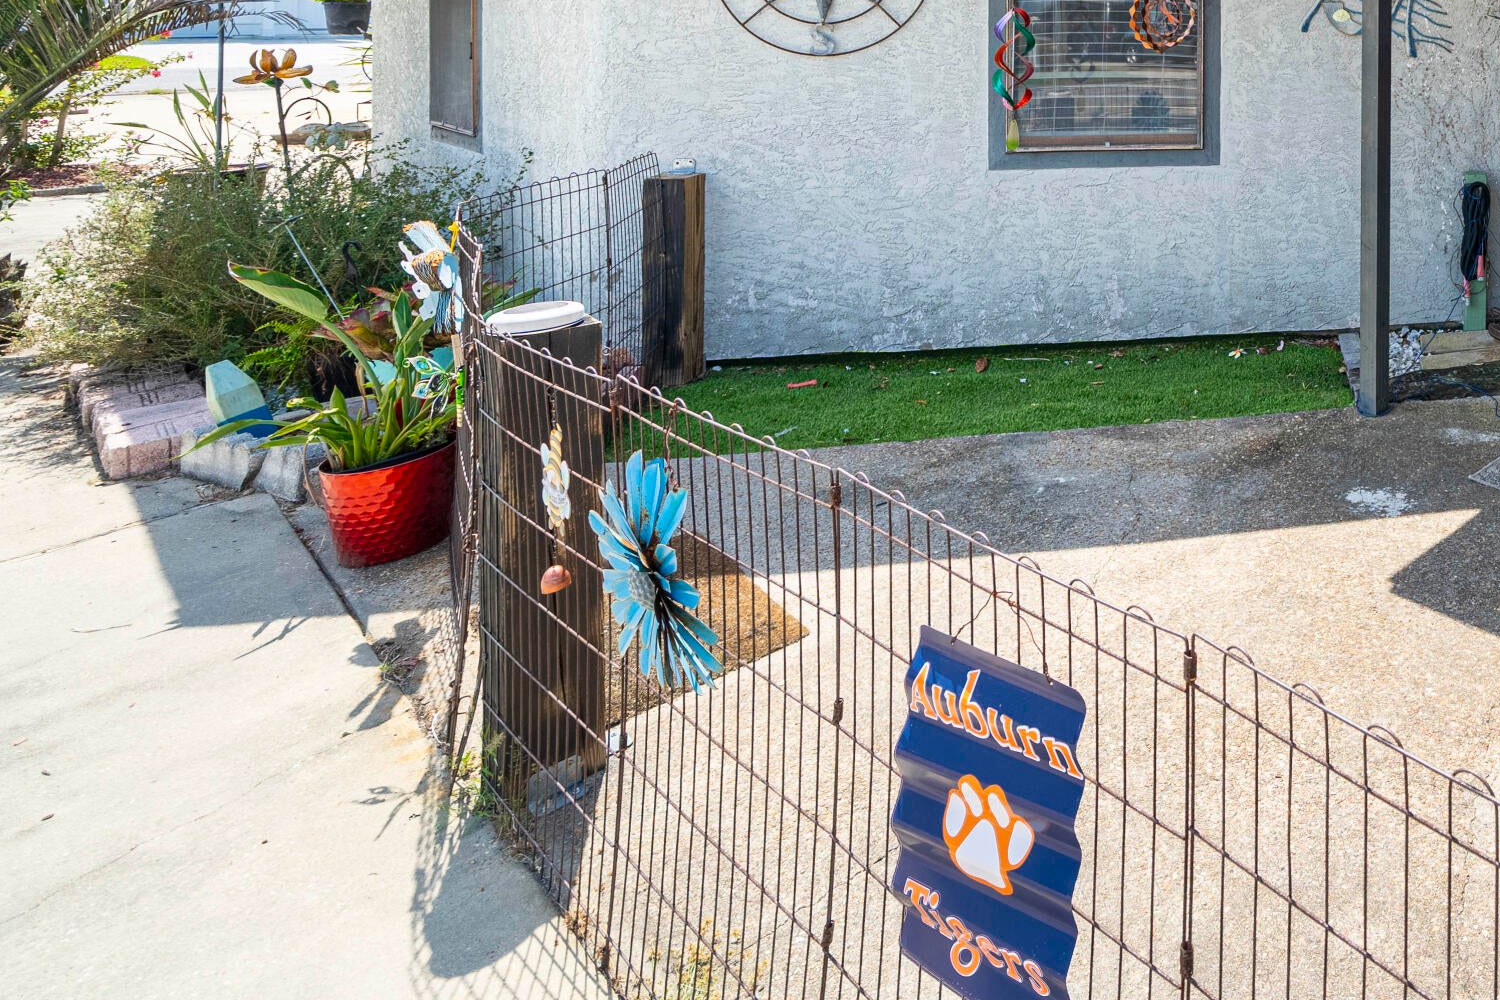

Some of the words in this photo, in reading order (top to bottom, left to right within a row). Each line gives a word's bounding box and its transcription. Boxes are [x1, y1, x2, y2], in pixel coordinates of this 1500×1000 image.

[809, 23, 837, 55] S
[909, 661, 1084, 781] Auburn
[904, 876, 1050, 998] Tigers
